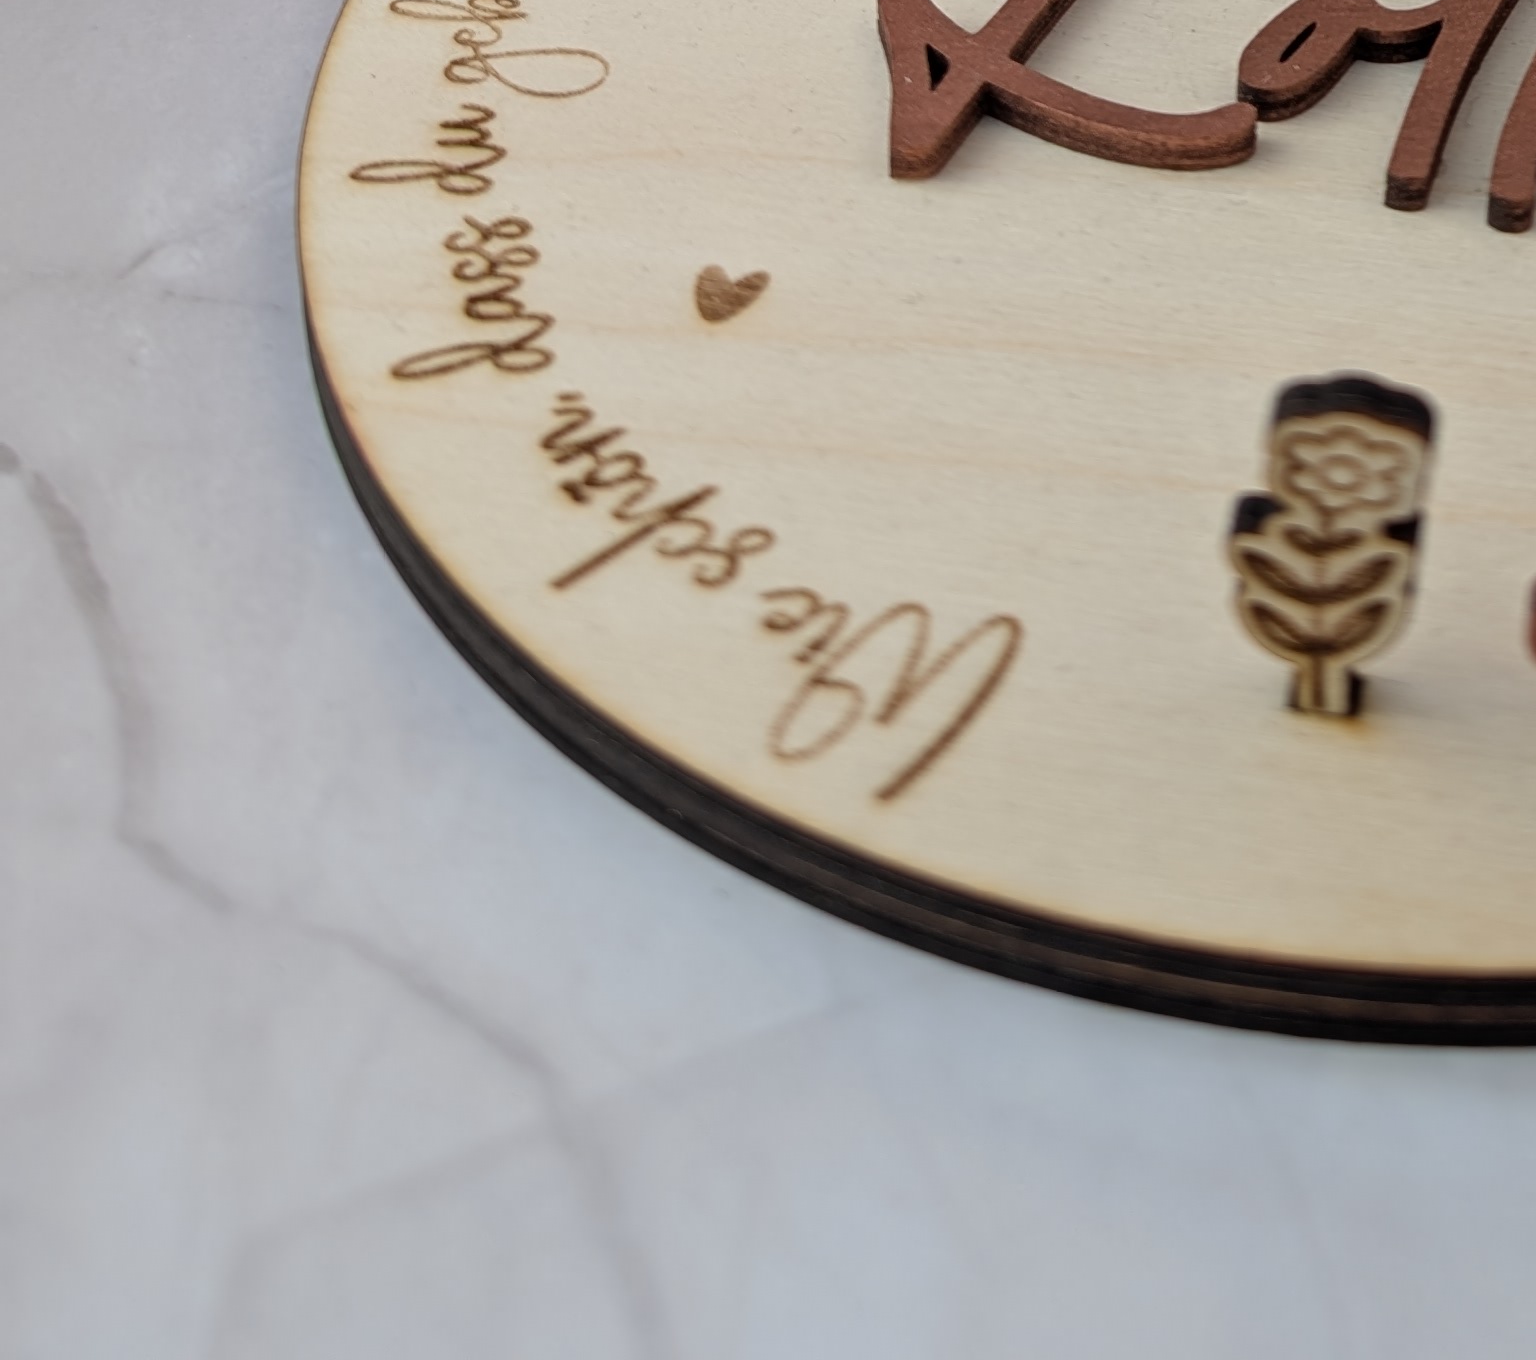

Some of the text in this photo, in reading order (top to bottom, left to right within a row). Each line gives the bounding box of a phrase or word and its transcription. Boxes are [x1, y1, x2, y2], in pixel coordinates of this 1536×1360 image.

[350, 104, 506, 194] du
[392, 217, 555, 380] dass
[540, 393, 776, 588] schön,
[763, 587, 1023, 800] Wie
